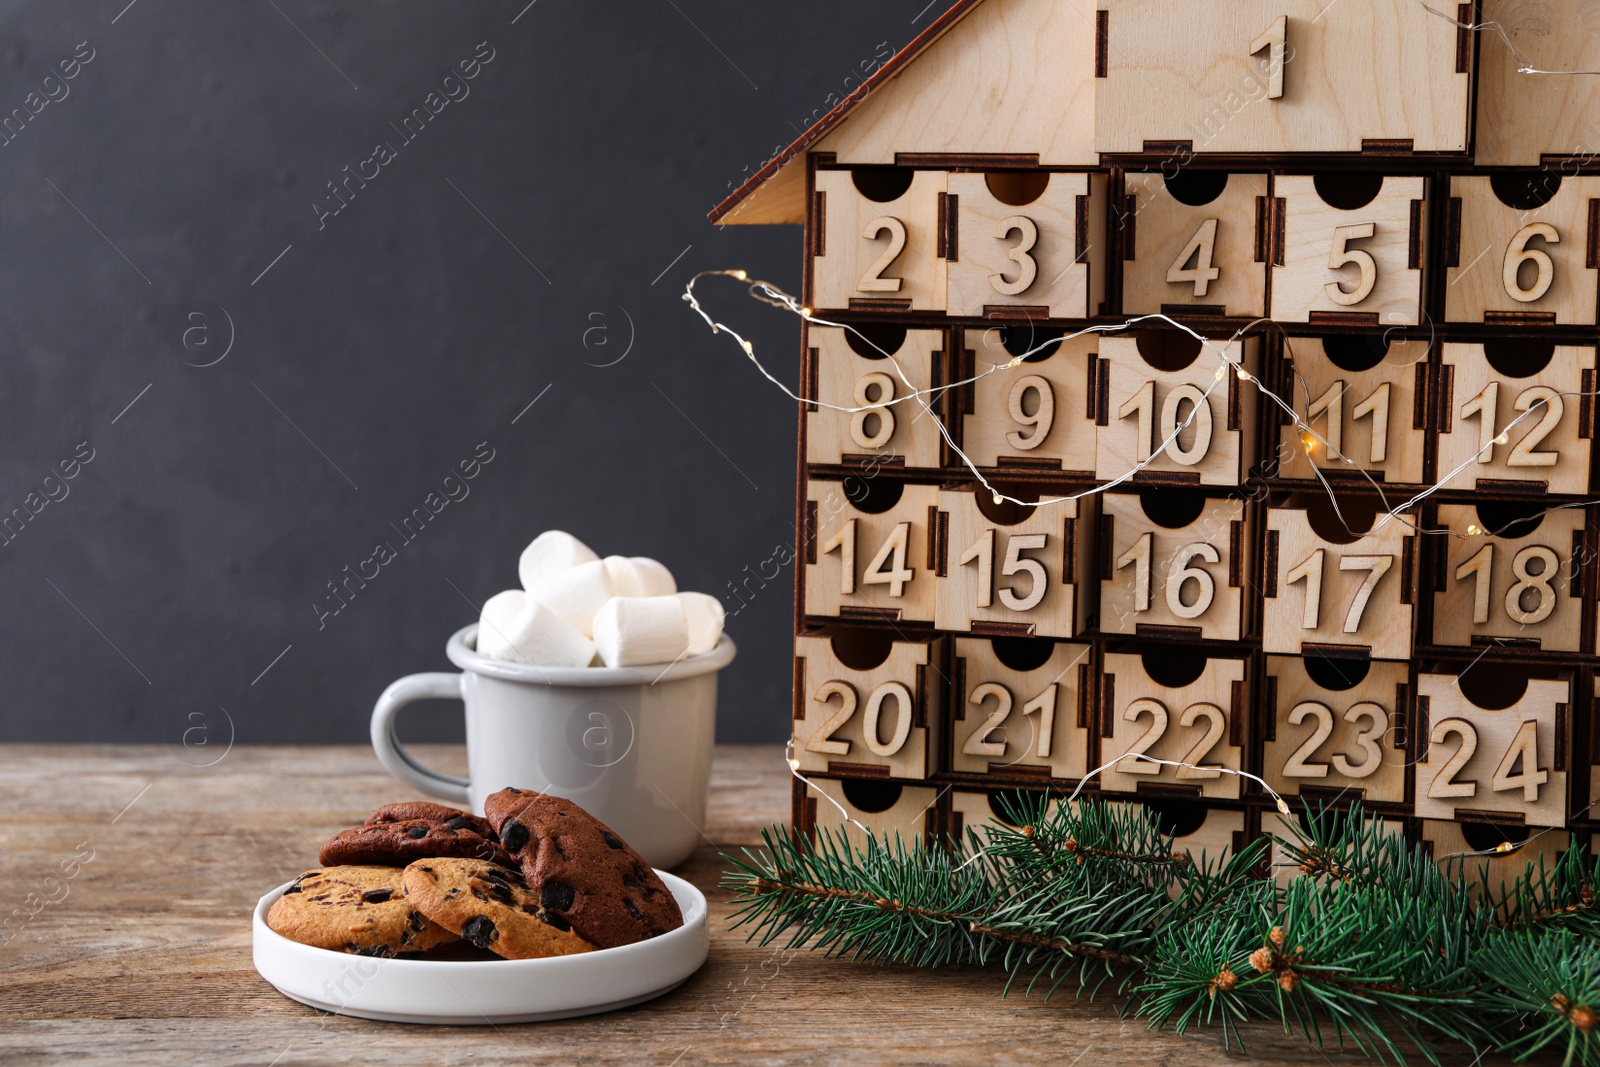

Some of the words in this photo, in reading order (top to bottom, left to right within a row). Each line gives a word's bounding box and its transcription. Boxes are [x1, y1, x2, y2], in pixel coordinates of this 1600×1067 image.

[1250, 14, 1288, 99] 1
[856, 215, 907, 292] 2
[988, 215, 1039, 295] 3
[1165, 218, 1219, 297] 4
[1325, 222, 1376, 306] 5
[1502, 222, 1560, 302] 6
[849, 372, 896, 450] 8
[1007, 374, 1055, 450] 9
[1119, 380, 1213, 466] 10
[1308, 380, 1391, 463] 11
[1460, 381, 1564, 467] 12
[823, 518, 915, 597] 14
[960, 529, 1048, 611] 15
[1116, 532, 1220, 619] 16
[1287, 548, 1393, 633] 17
[1456, 543, 1561, 624] 18
[804, 680, 914, 757] 20
[961, 682, 1058, 758] 21
[1114, 697, 1226, 780] 22
[1282, 701, 1389, 778] 23
[1426, 718, 1548, 802] 24
